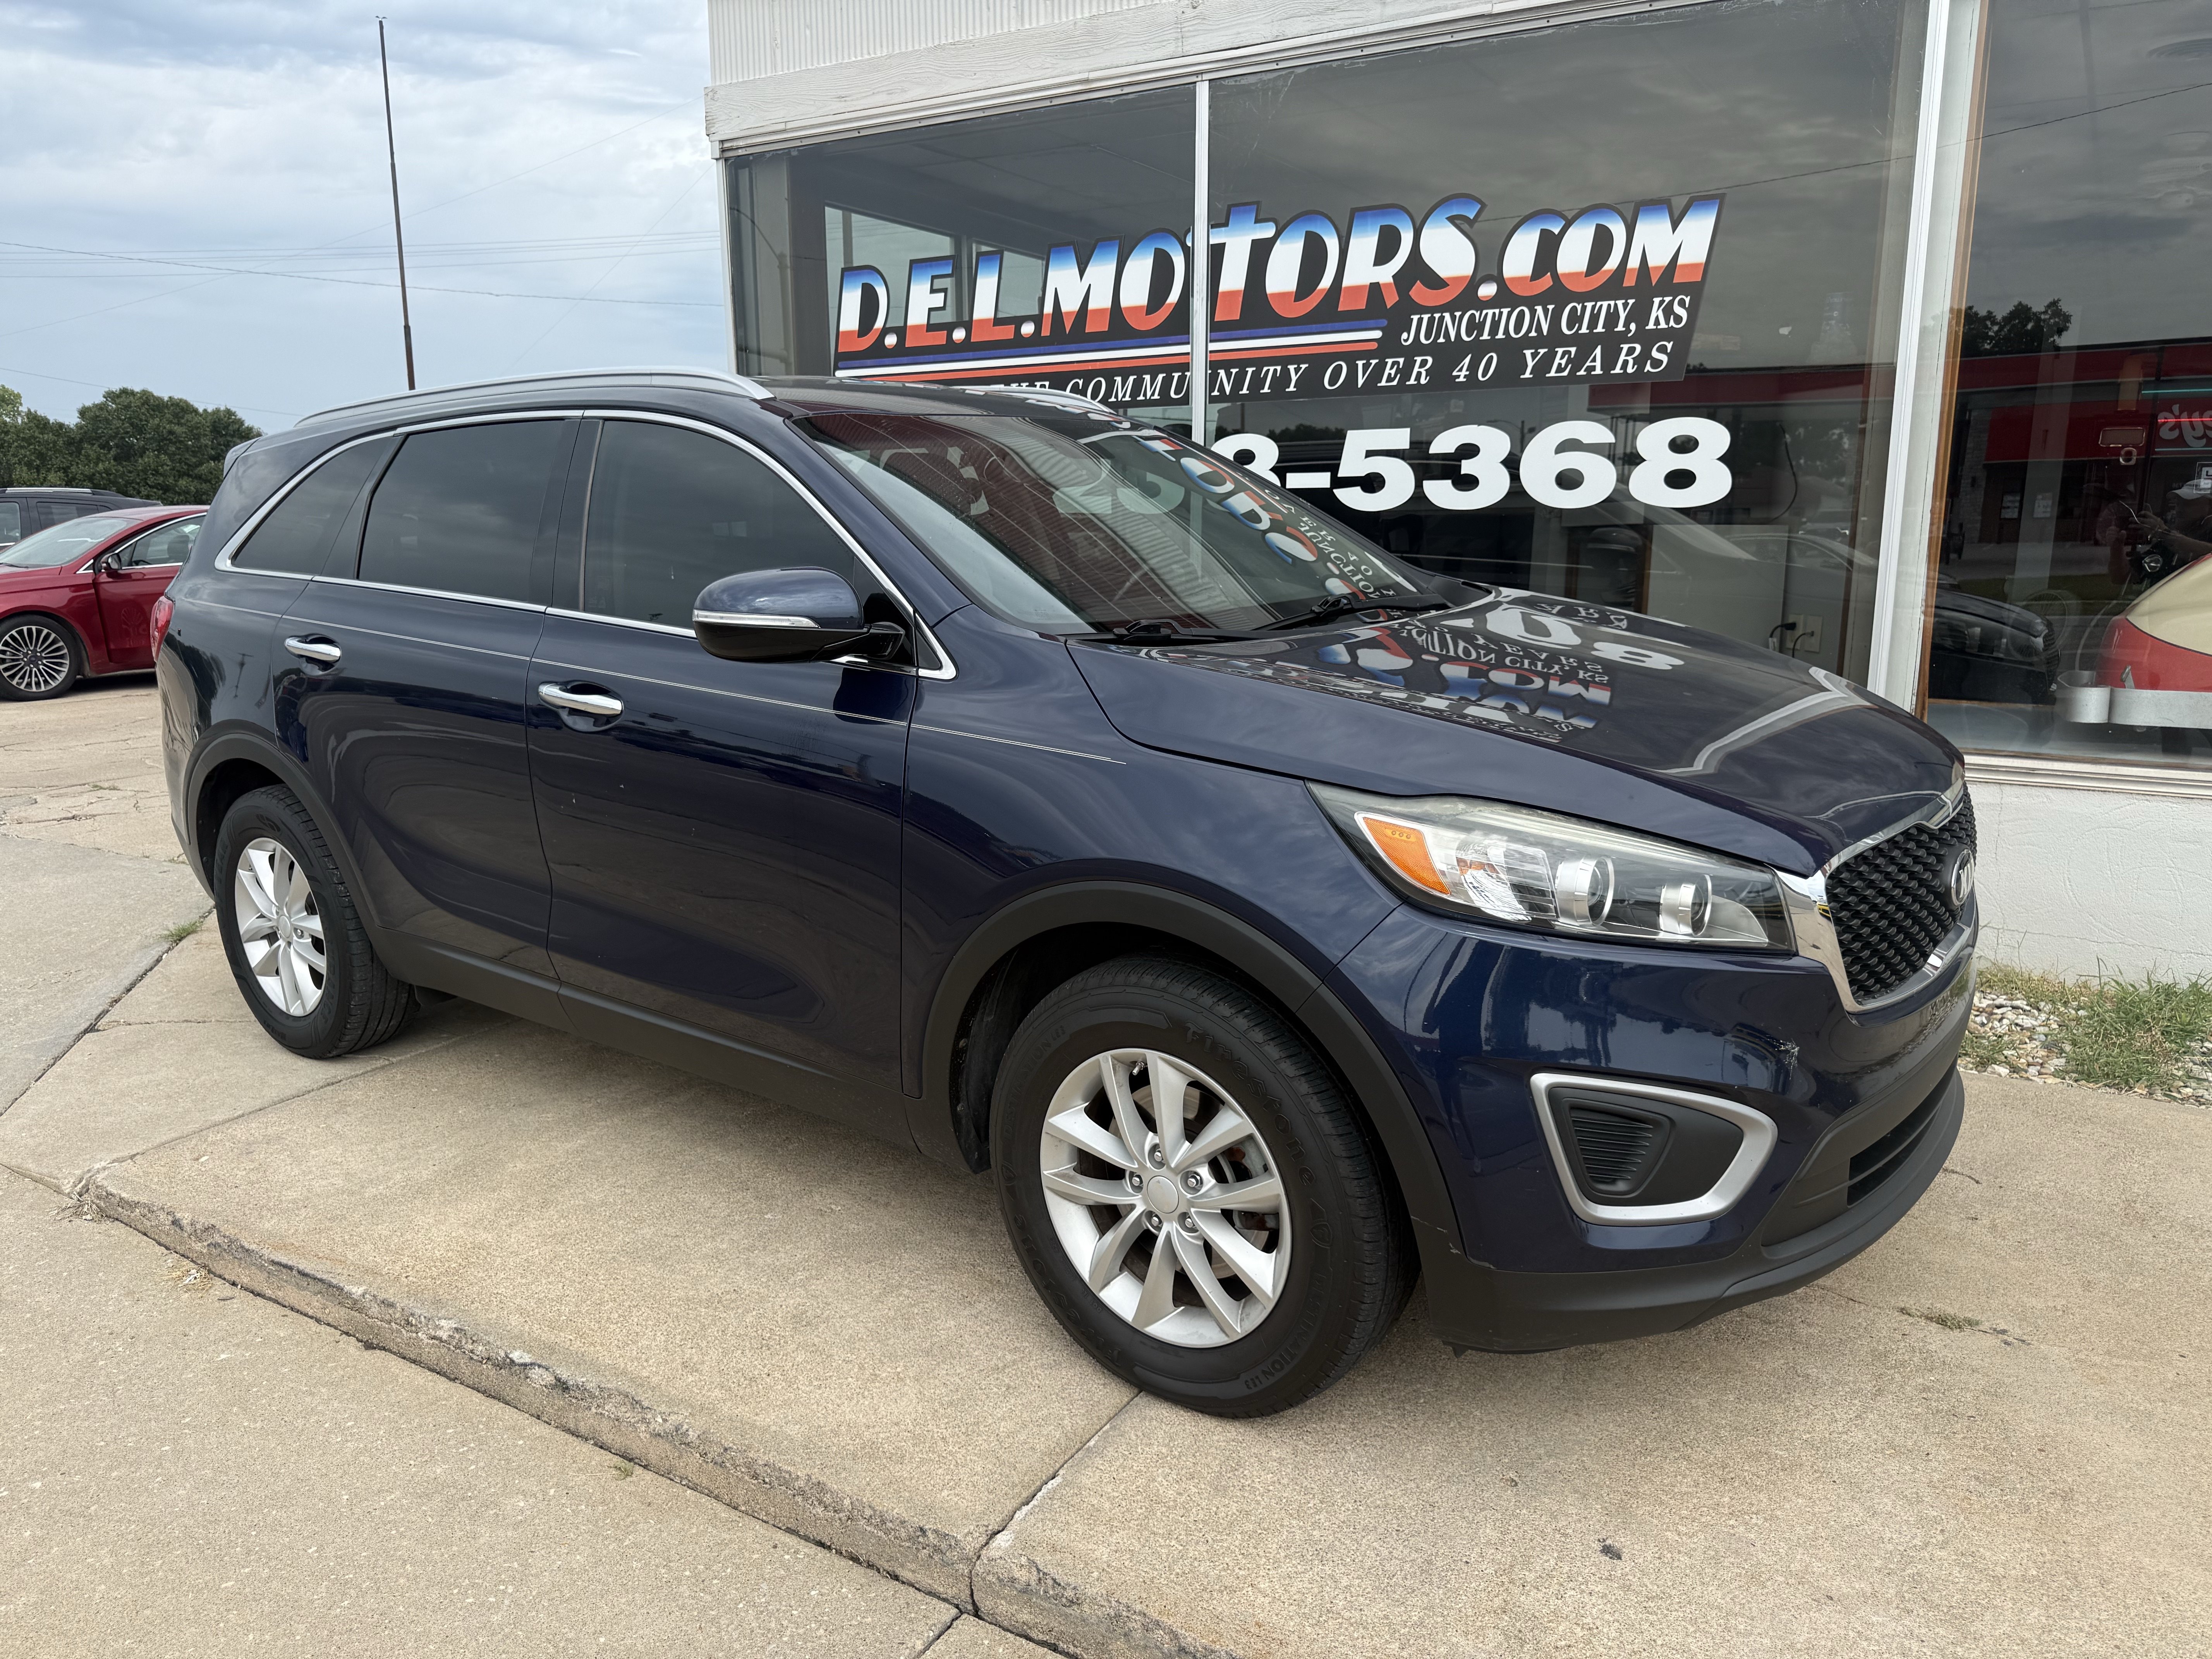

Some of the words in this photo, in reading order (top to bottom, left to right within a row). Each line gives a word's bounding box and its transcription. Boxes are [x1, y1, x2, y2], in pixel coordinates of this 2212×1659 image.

[1400, 305, 1555, 345] JUNCTION
[1560, 299, 1637, 337] CITY,
[1645, 295, 1690, 330] KS
[1065, 364, 1309, 403] COMMUNITY
[1323, 356, 1434, 390] OVER
[1452, 352, 1498, 381] 40
[1520, 342, 1673, 379] YEARS
[1184, 1020, 1316, 1187] Firestone
